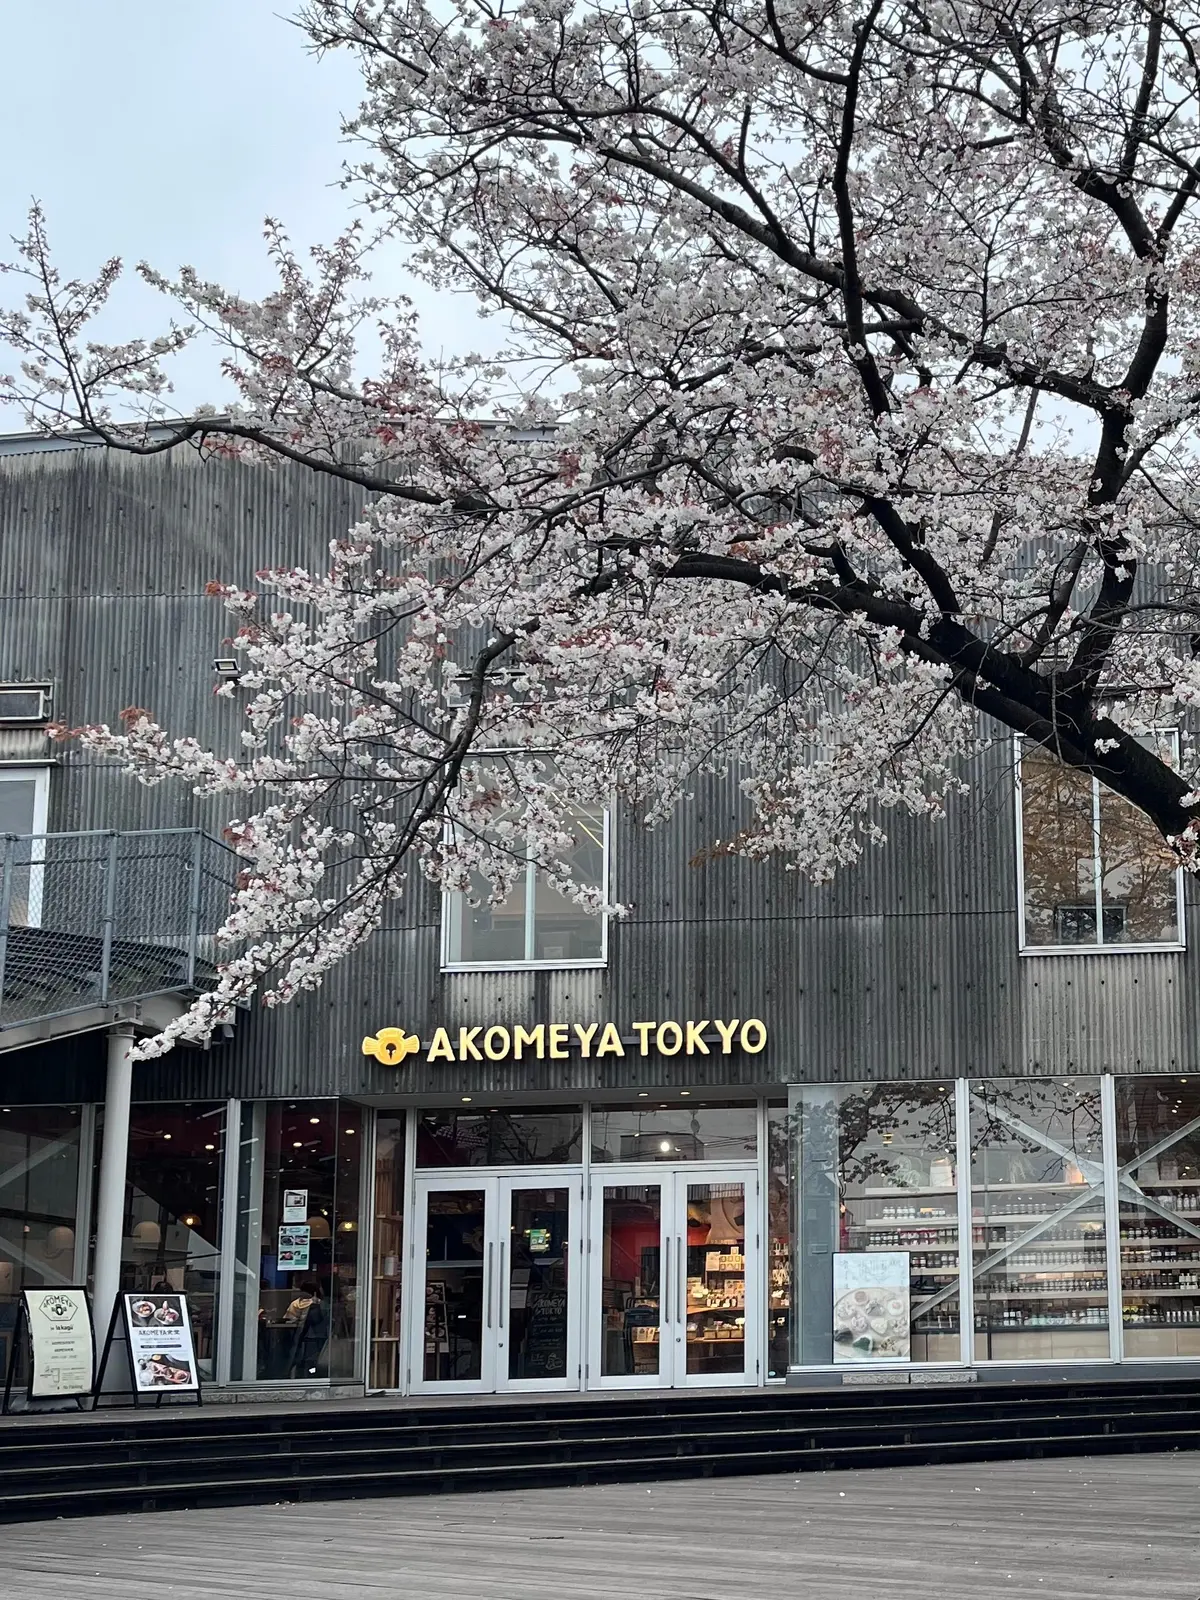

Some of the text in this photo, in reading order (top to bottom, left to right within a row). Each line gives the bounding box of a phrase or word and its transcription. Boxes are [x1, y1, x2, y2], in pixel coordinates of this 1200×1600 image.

[427, 1018, 767, 1062] AKOMEYA TOKYO
[43, 1295, 73, 1308] AKOMEYA
